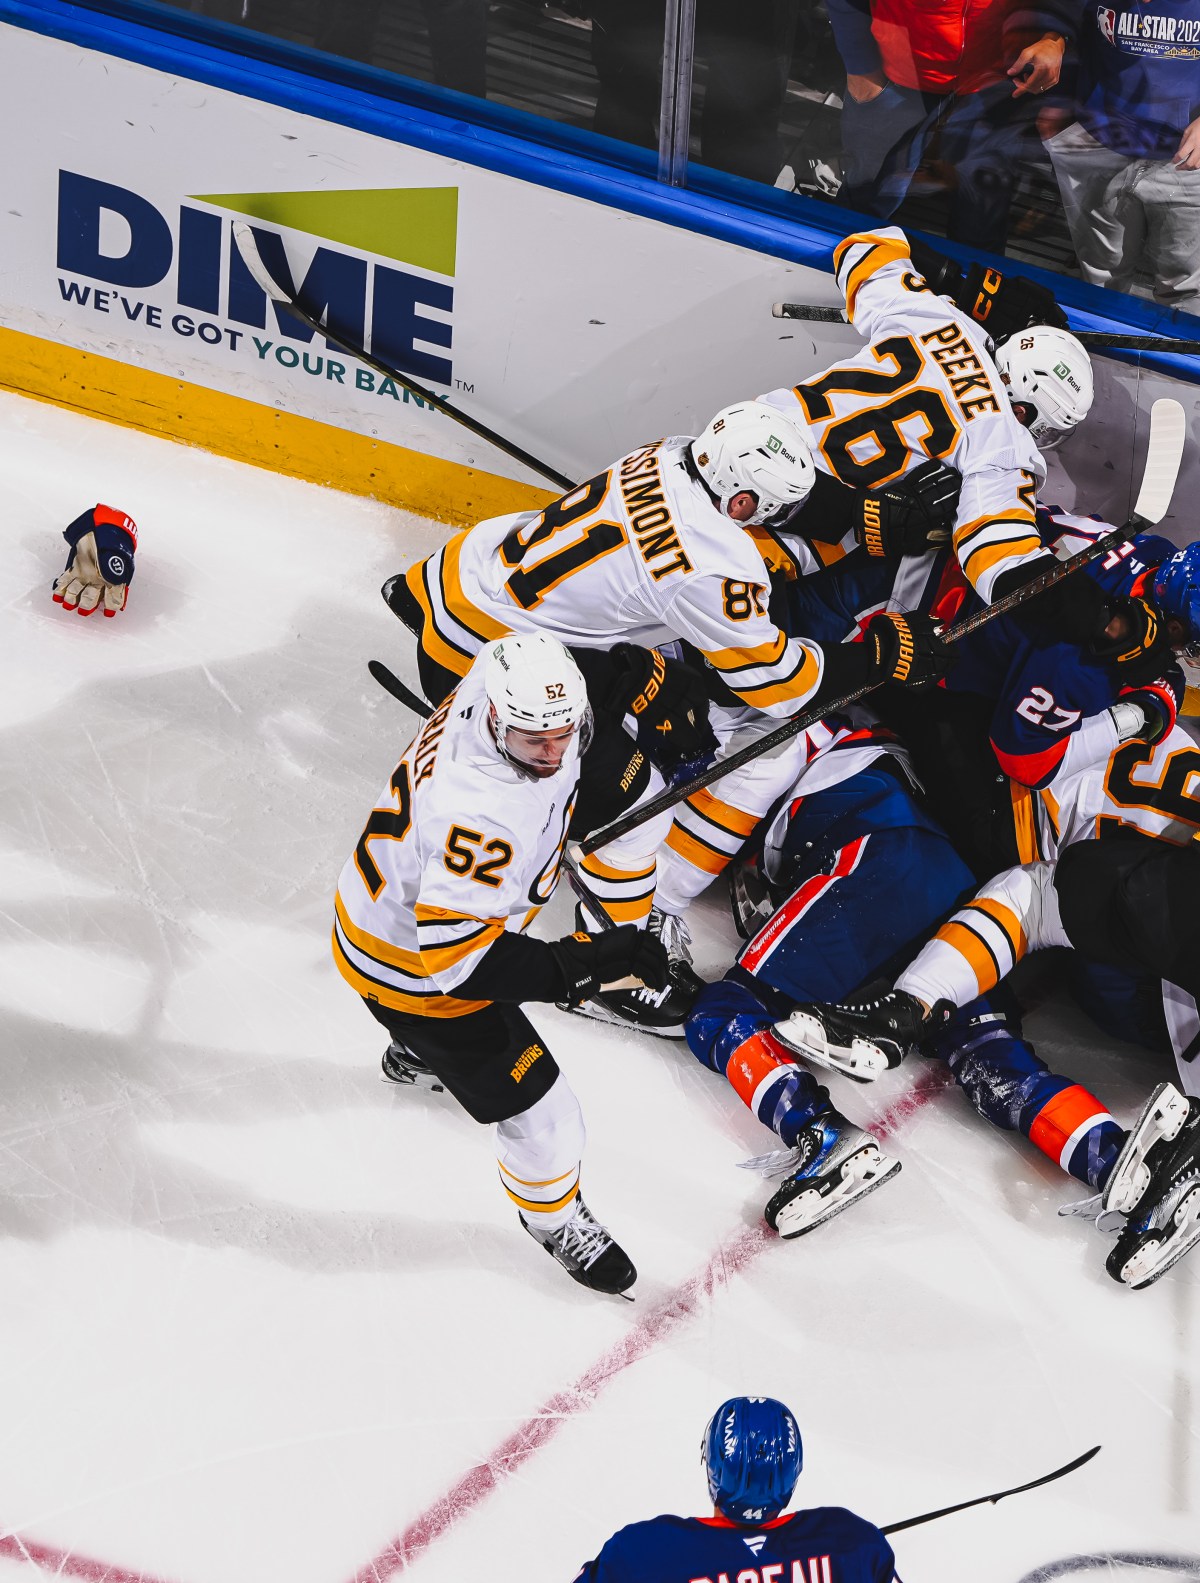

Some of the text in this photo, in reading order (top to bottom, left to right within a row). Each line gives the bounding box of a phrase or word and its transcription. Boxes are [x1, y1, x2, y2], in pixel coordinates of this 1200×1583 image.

[1118, 12, 1139, 37] ALL
[1142, 15, 1176, 42] STAR
[1134, 41, 1170, 51] FRANCISCO
[1143, 47, 1159, 55] AREA
[57, 169, 454, 387] DIME
[171, 314, 244, 352] GOT
[251, 336, 347, 384] YOUR
[1019, 335, 1035, 351] 26
[919, 321, 1001, 423] PEEKE
[455, 378, 475, 394] TM
[1066, 375, 1082, 394] Bank
[792, 334, 962, 490] 26
[712, 418, 726, 435] 81
[780, 448, 797, 465] Bank
[499, 468, 631, 611] 81
[498, 654, 511, 673] Bank
[545, 683, 567, 700] 52
[542, 707, 573, 719] CCM
[1016, 686, 1083, 732] 27
[619, 751, 645, 793] BRUINS
[443, 823, 515, 890] 52
[510, 1043, 544, 1084] BRUINS
[742, 1508, 763, 1520] 44
